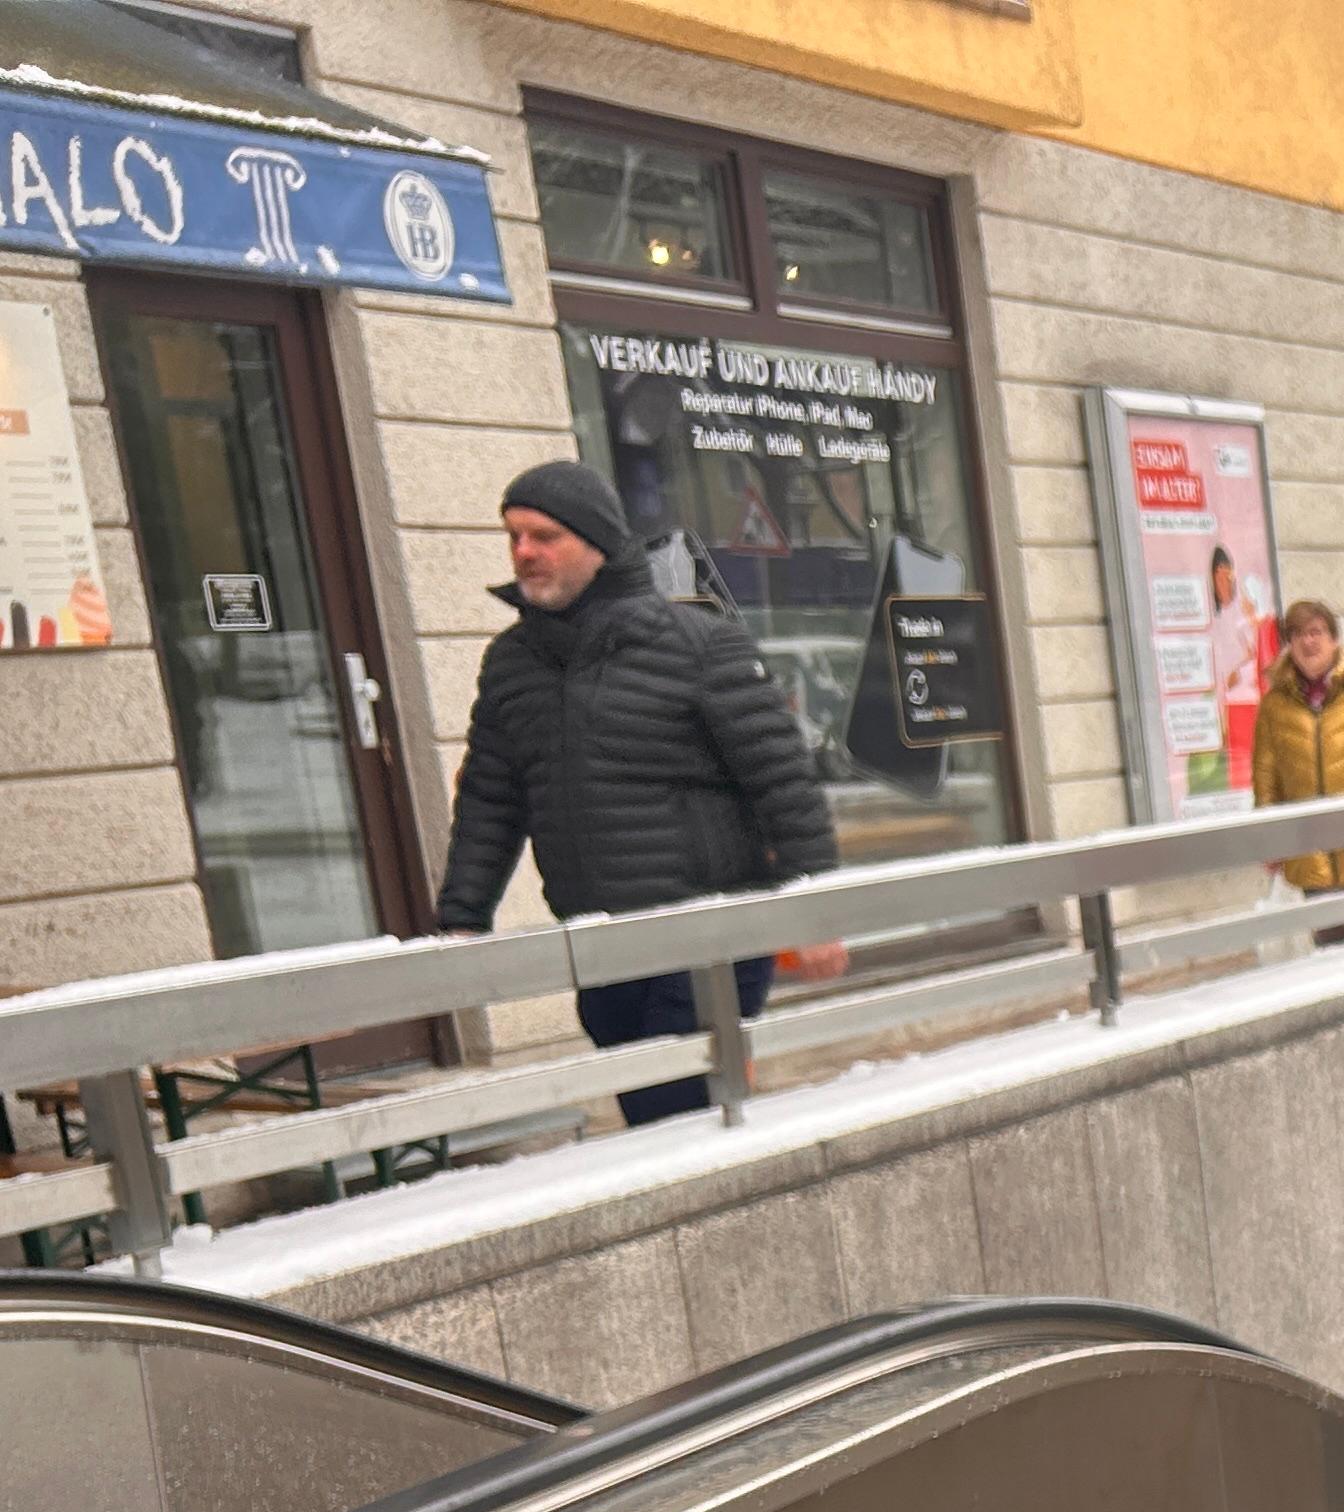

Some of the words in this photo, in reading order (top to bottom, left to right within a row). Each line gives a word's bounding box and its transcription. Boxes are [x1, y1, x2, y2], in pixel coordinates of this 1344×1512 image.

[0, 131, 185, 250] ALO
[589, 335, 712, 379] VERKAUF
[717, 347, 770, 386] UND
[774, 357, 861, 397] ANKAUF
[681, 387, 754, 417] Reparatur
